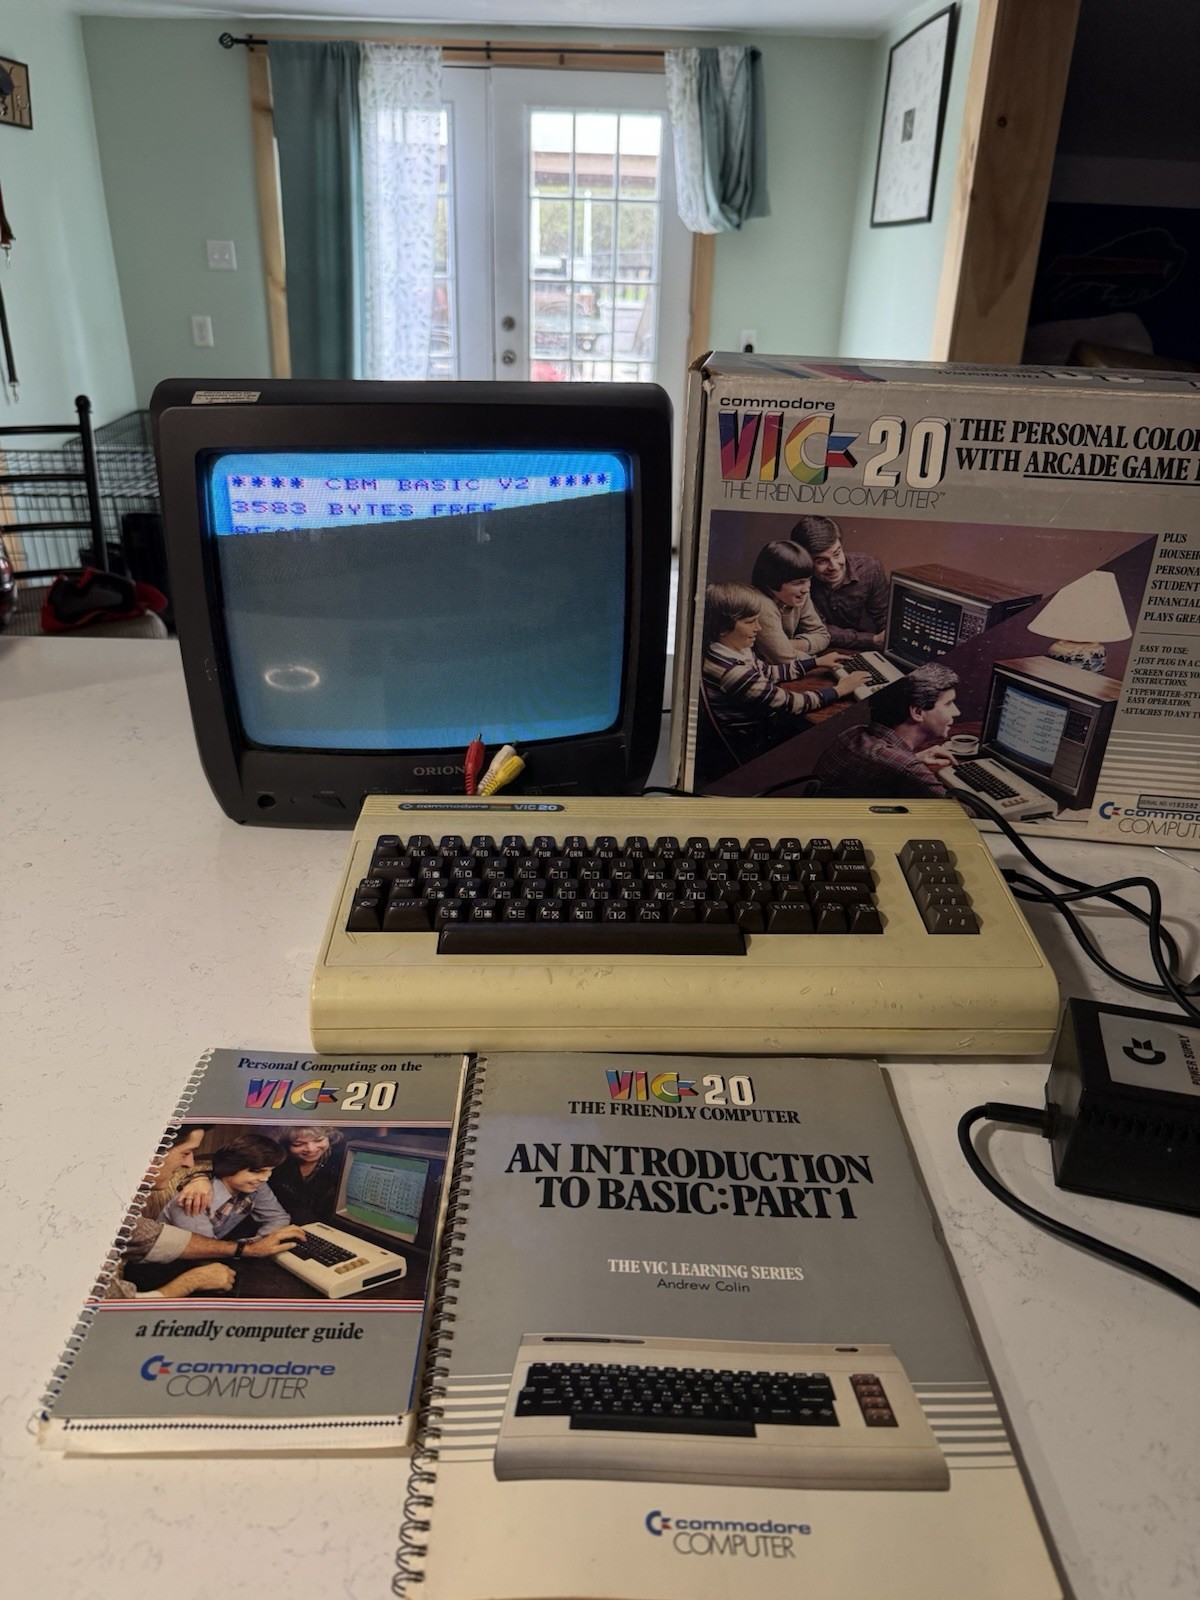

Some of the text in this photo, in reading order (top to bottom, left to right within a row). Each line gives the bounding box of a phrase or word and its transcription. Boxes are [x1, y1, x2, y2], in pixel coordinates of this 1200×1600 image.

[720, 398, 835, 410] commodore
[960, 418, 1006, 443] THE
[1010, 420, 1128, 448] PERSONAL
[862, 415, 951, 489] 20
[955, 447, 1022, 472] WITH
[1024, 450, 1119, 477] ARCADE
[1122, 455, 1191, 480] GAME
[325, 478, 377, 491] CBM
[398, 478, 480, 491] BASIC
[499, 477, 529, 490] V2
[721, 480, 751, 500] THE
[833, 486, 940, 509] COMPUTER
[232, 501, 307, 515] 3583
[328, 503, 414, 517] BYTES
[1163, 533, 1187, 544] PLUS
[1159, 549, 1200, 560] HOUSEH
[1155, 565, 1200, 576] PERSONA
[1151, 580, 1200, 592] STUDENT
[1143, 612, 1174, 623] PLAYS
[1139, 645, 1159, 653] EASY
[1136, 657, 1156, 665] JUST
[1157, 658, 1176, 666] PLUG
[1132, 668, 1163, 677] SCREEN
[1165, 670, 1188, 678] GIVES
[1127, 696, 1147, 704] EASY
[1124, 707, 1162, 716] ATTACHES
[1164, 709, 1174, 717] TO
[1174, 710, 1191, 718] ANY
[413, 766, 465, 777] ORION
[238, 1057, 422, 1074] Personal Computing on the
[340, 1080, 399, 1111] 20
[702, 1074, 756, 1106] 20
[568, 1101, 801, 1124] THE FRIENDLY COMPUTER
[504, 1143, 874, 1184] AN INTRODUCTION
[535, 1176, 590, 1208] TO
[607, 1258, 804, 1281] THE VIC LEARNING SERIES
[657, 1278, 750, 1293] Andrew Colin
[136, 1320, 364, 1343] a friendly computer guide
[176, 1361, 336, 1377] commodore
[166, 1375, 308, 1400] COMPUTER
[675, 1518, 811, 1536] commodore
[673, 1532, 795, 1559] COMPUTER
